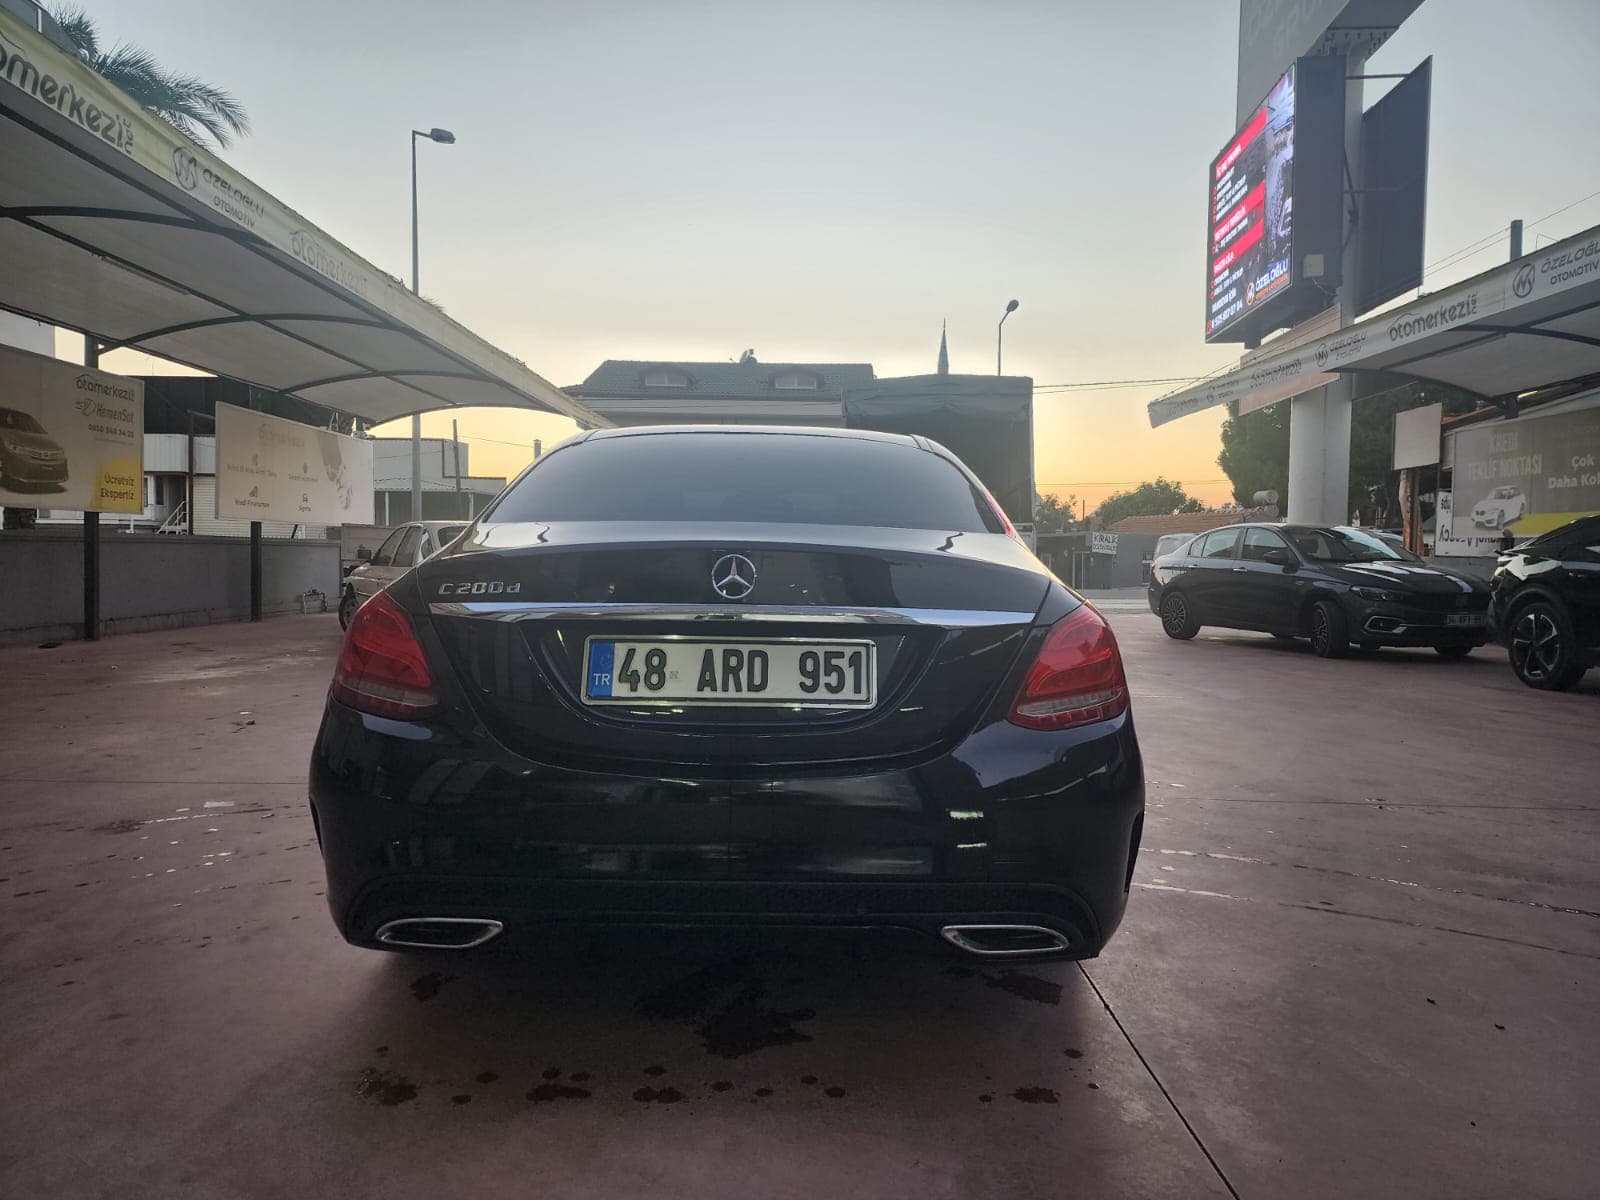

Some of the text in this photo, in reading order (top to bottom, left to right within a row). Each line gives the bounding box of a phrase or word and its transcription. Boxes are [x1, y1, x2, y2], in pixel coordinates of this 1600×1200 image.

[1389, 295, 1471, 342] otomerkezi
[1571, 454, 1595, 471] Çok
[1548, 475, 1578, 489] Daha
[593, 647, 862, 695] TR 48 ARD 951
